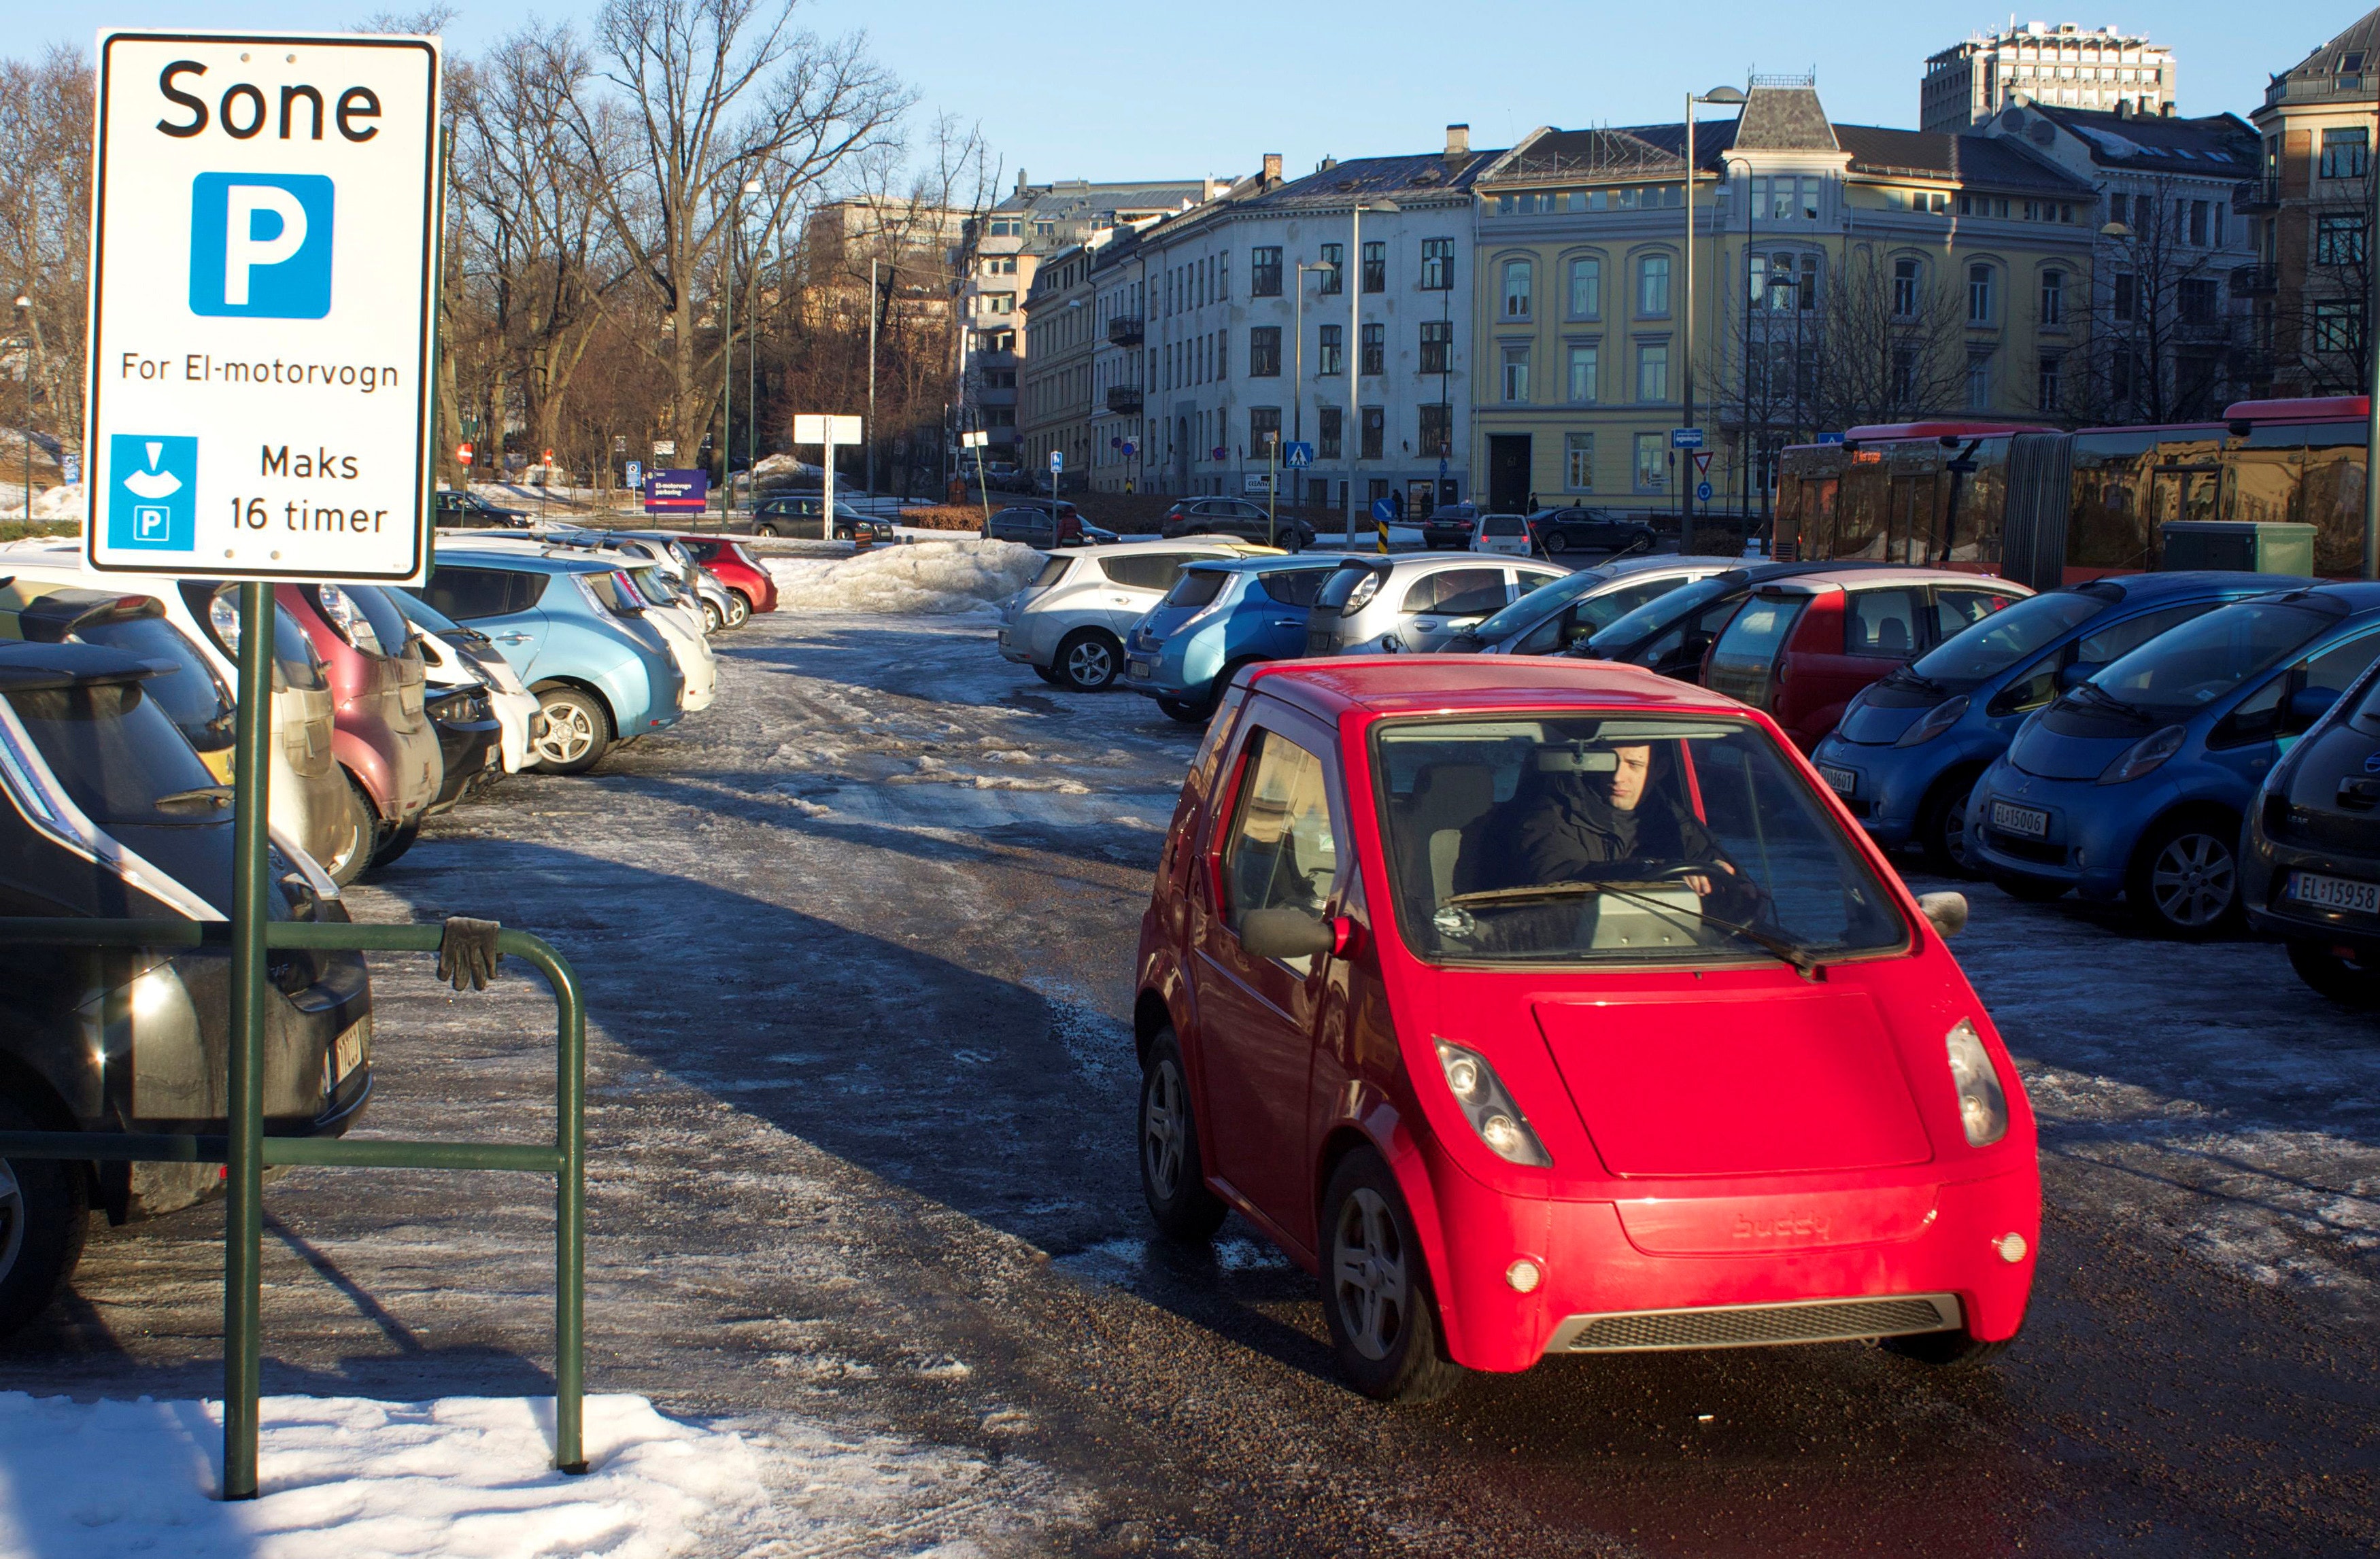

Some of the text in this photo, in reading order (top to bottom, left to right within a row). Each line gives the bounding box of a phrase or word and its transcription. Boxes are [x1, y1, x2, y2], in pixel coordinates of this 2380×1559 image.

[156, 60, 381, 143] Sone
[224, 185, 308, 305] P
[123, 353, 396, 392] For El-motorvogn
[262, 445, 357, 479] Maks
[142, 510, 162, 536] P
[233, 498, 387, 532] 16 timer
[1731, 1212, 1833, 1241] buddy
